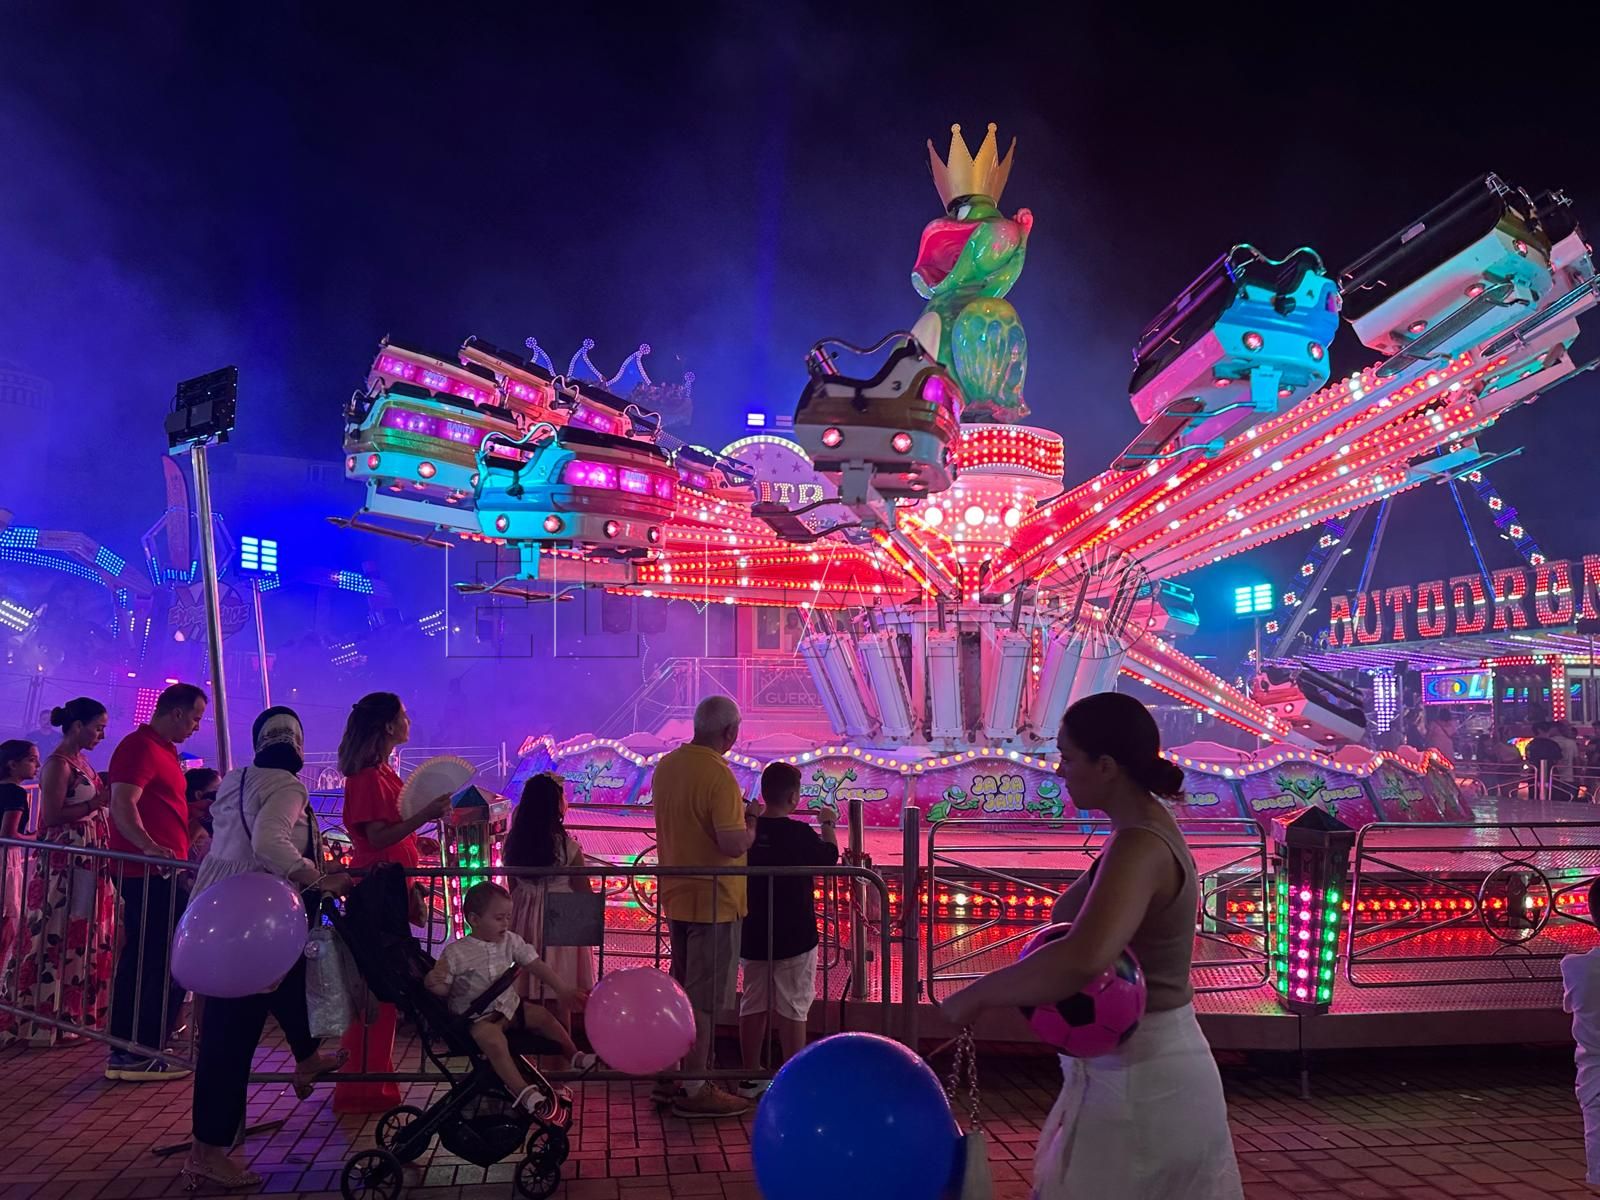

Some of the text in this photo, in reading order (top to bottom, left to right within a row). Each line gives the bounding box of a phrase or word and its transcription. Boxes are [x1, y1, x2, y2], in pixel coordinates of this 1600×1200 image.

[891, 380, 902, 391] 3
[972, 775, 1026, 794] JA JA
[983, 793, 1025, 812] JA!!
